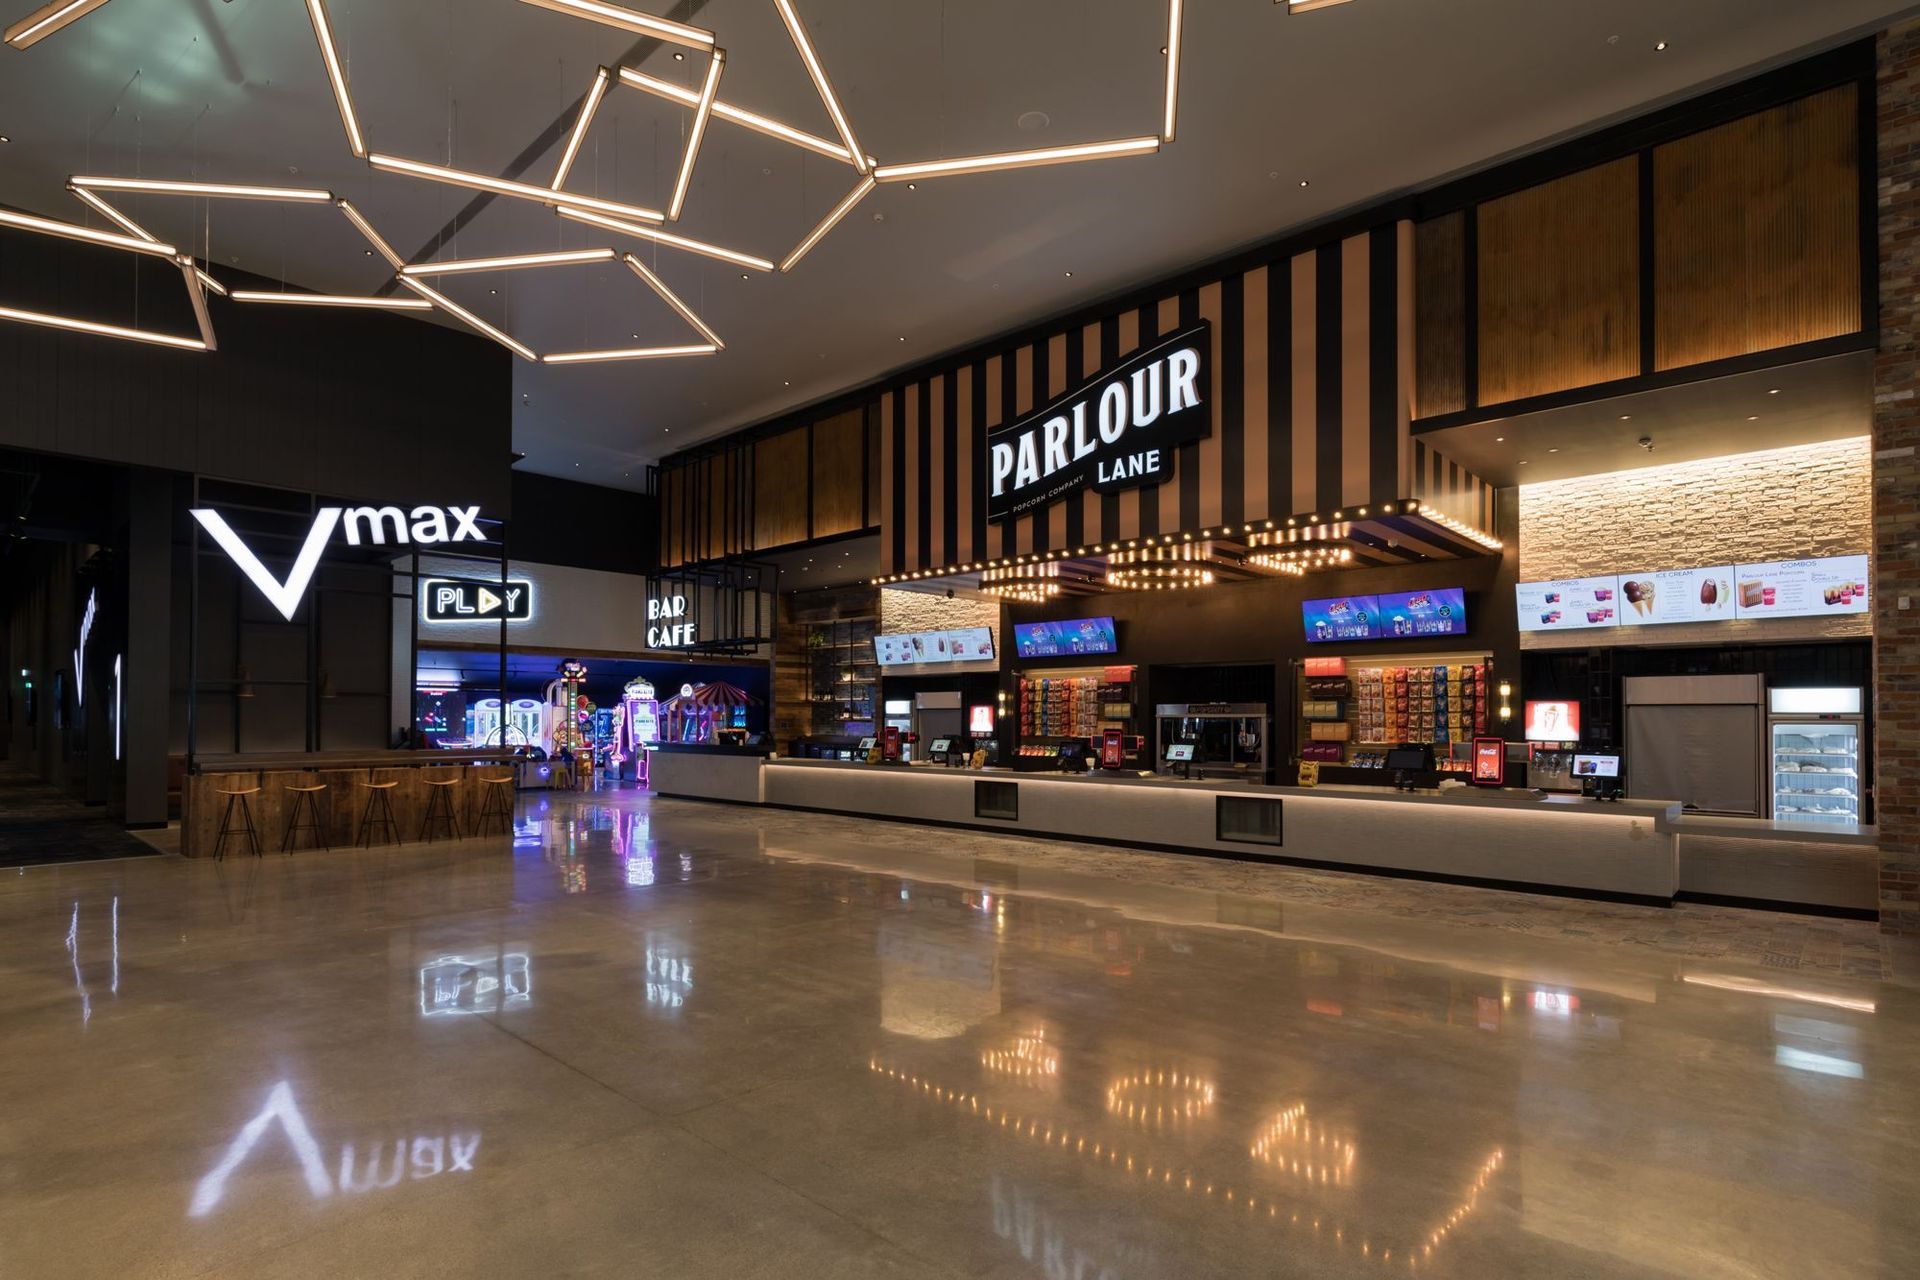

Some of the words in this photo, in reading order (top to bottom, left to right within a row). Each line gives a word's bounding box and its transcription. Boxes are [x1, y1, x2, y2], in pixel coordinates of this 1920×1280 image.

[991, 348, 1200, 497] PARLOUR
[1098, 450, 1160, 483] LANE
[1013, 494, 1046, 513] POPCORN
[1048, 474, 1084, 497] COMPANY
[189, 505, 488, 621] Vmax
[1668, 570, 1694, 578] CREAM
[1780, 560, 1817, 569] COMBOS
[1551, 580, 1580, 588] COMBOS
[648, 595, 686, 620] BAR
[648, 623, 696, 648] CAFE
